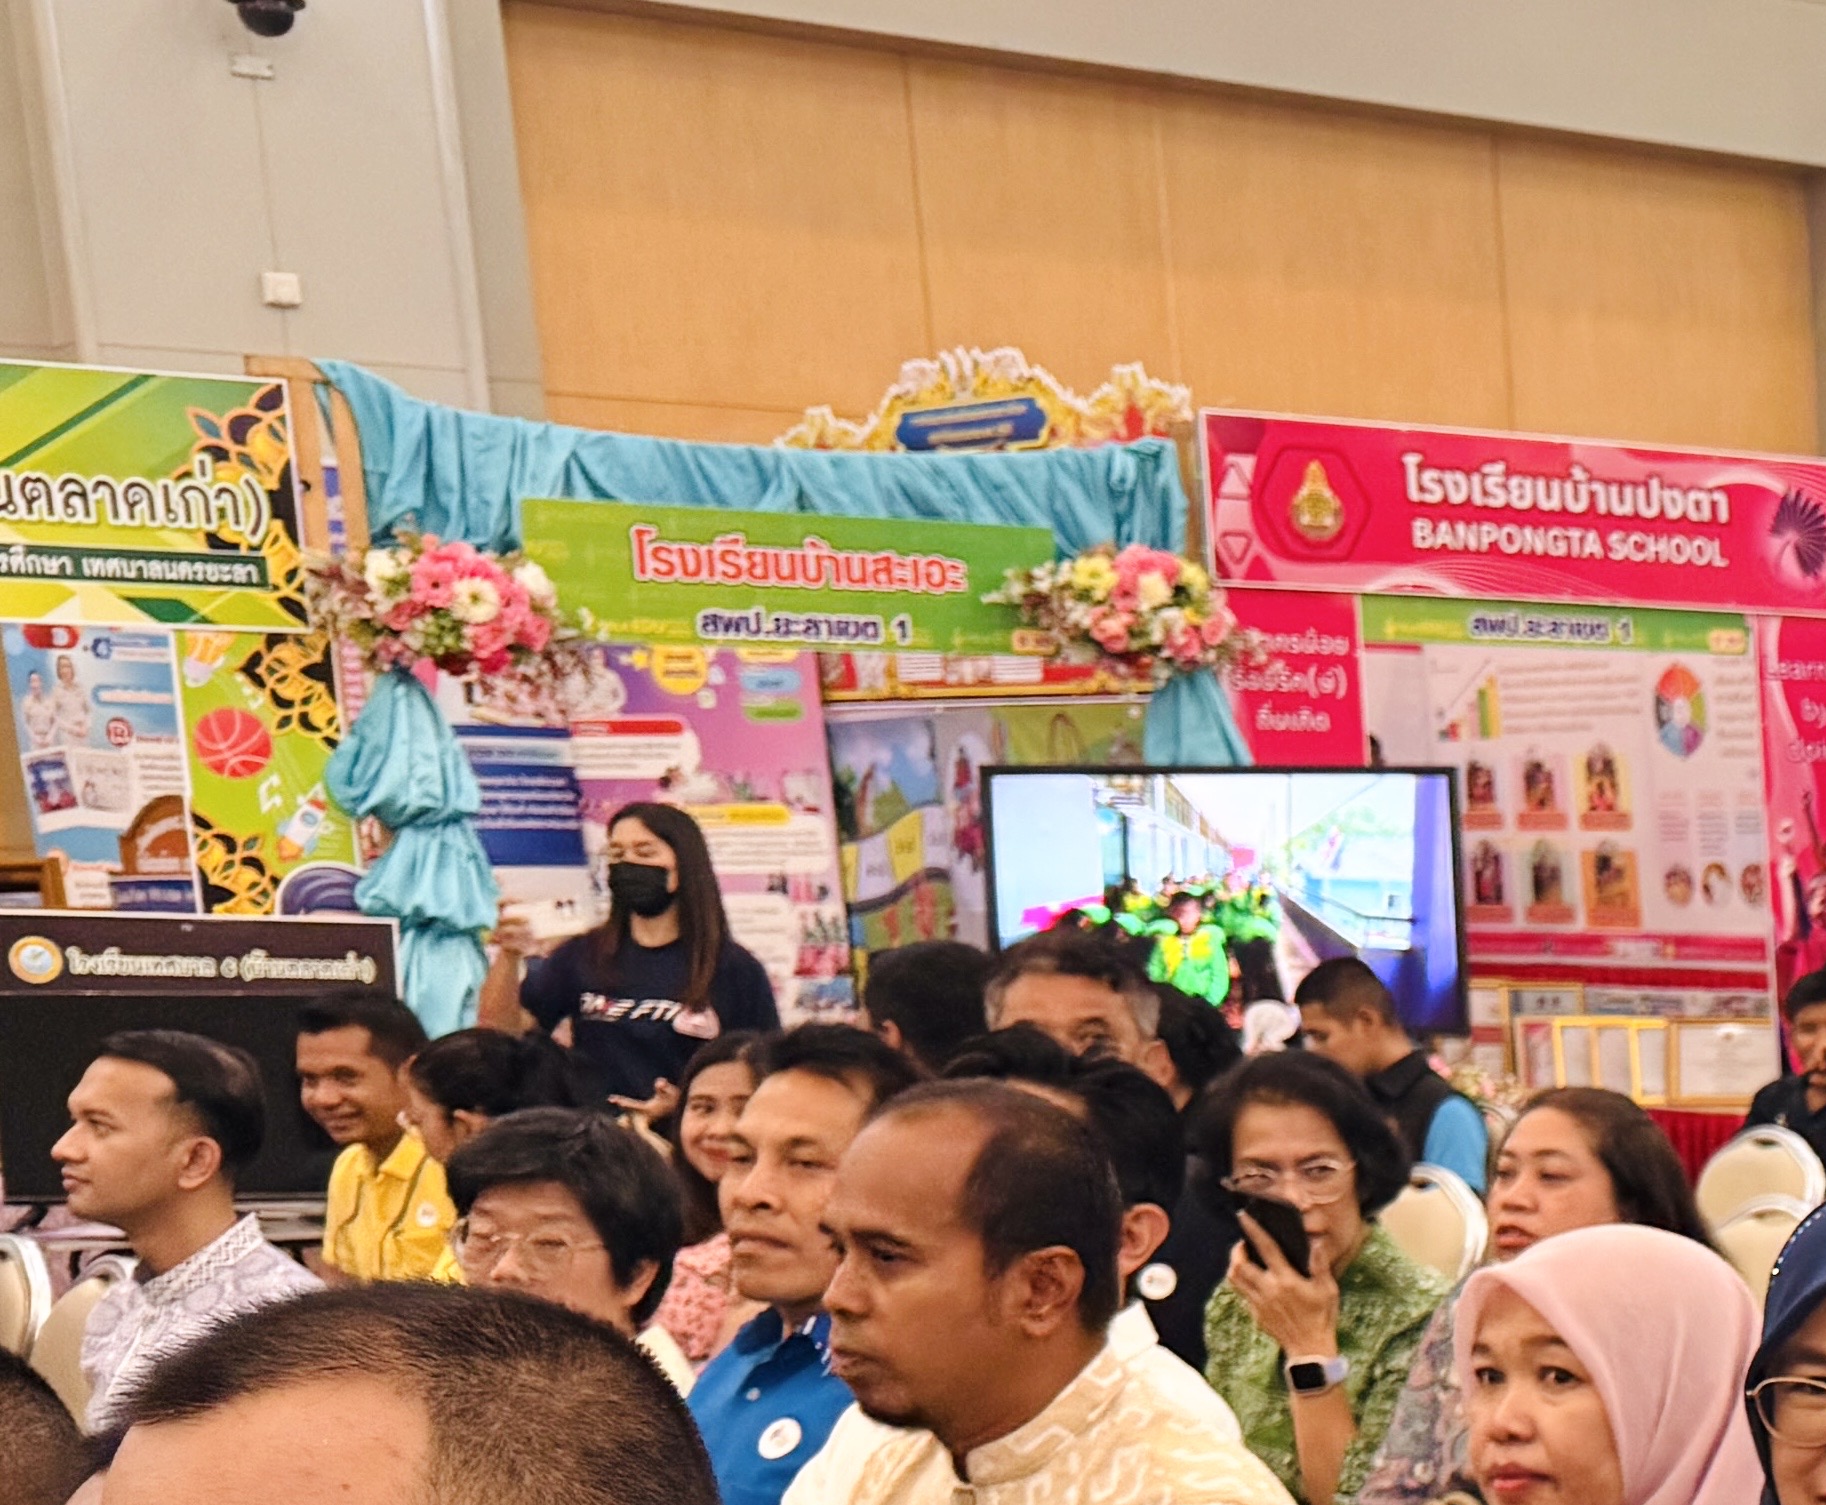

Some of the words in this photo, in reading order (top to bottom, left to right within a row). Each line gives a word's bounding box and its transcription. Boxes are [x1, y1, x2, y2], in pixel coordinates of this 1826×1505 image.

[1402, 452, 1730, 524] โรงเรียนบ้านปงตา
[631, 524, 967, 595] โรงเรียนบ้านสะเอะ
[1411, 517, 1604, 561] BANPONGTA
[1606, 529, 1730, 568] SCHOOL
[82, 554, 260, 584] เทศบาลนครยะลา
[891, 612, 912, 645] 1
